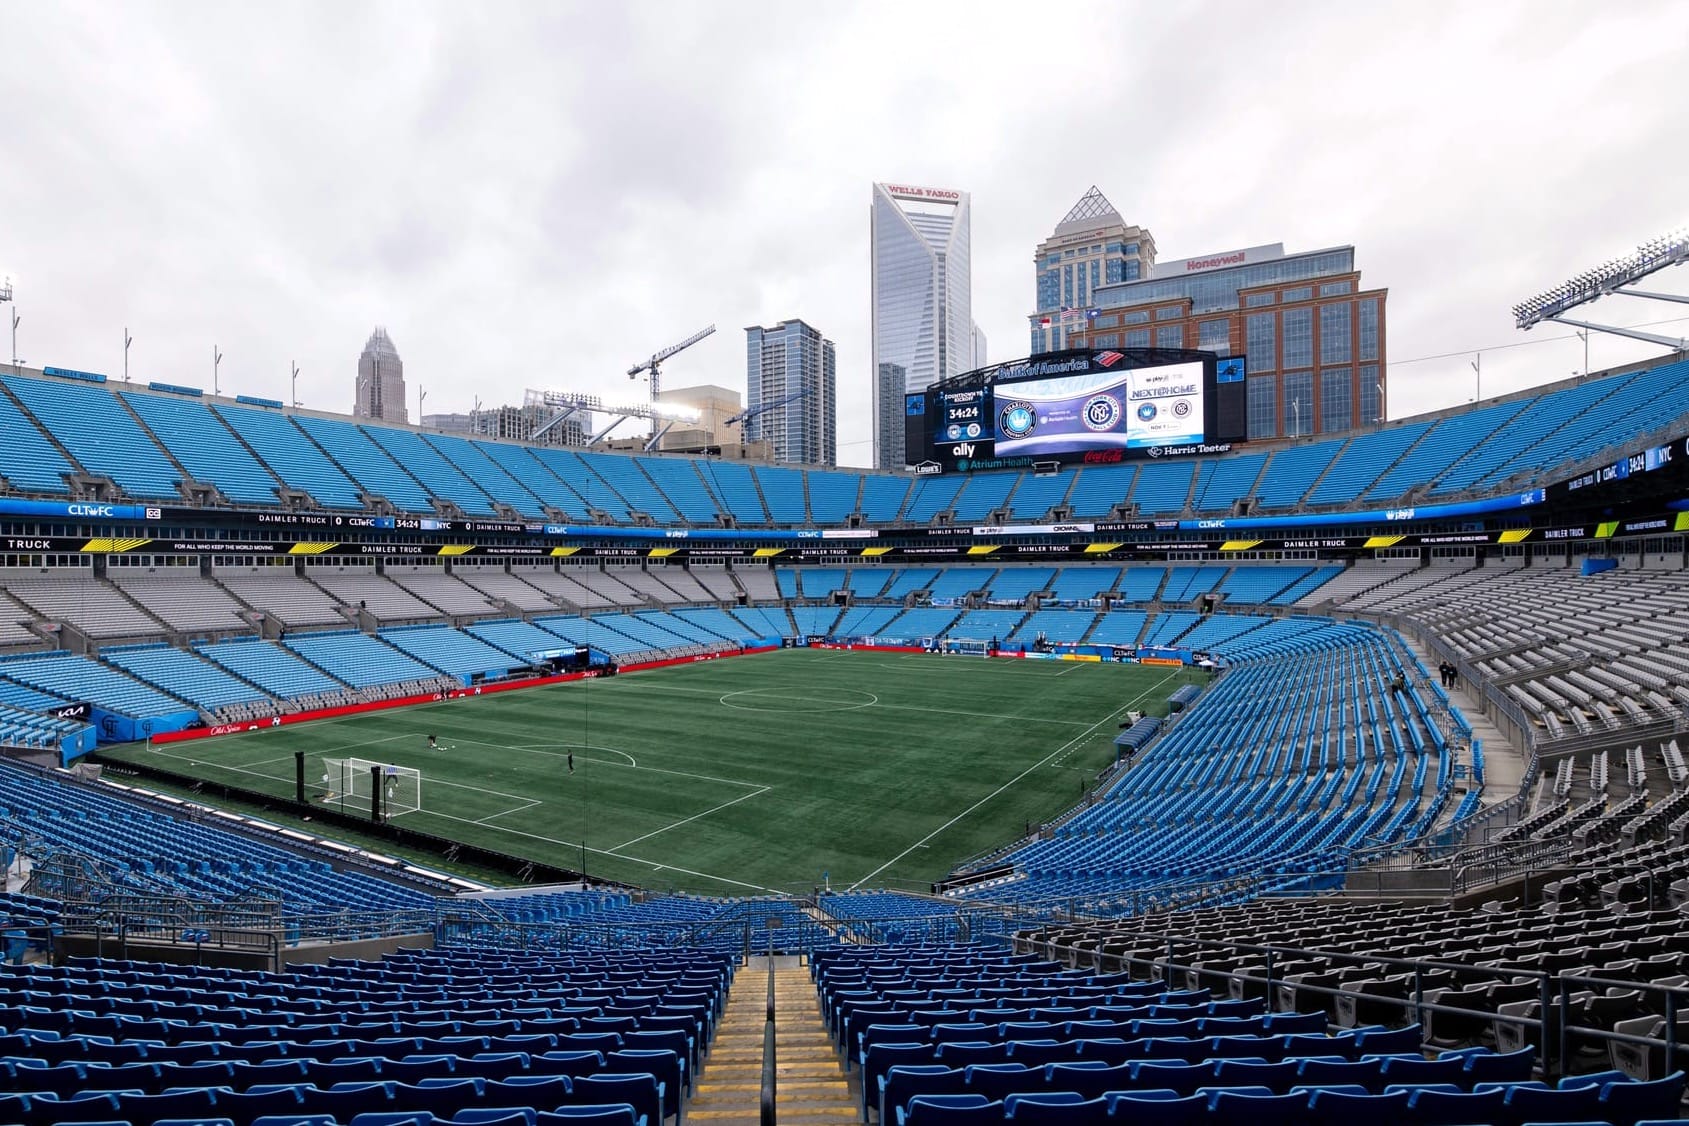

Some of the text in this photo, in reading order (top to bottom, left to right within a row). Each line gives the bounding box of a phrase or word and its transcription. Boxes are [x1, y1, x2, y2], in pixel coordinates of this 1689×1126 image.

[888, 185, 959, 199] WELLS FARGO
[1186, 252, 1245, 270] Honeywell
[997, 359, 1089, 379] Bank of America
[949, 407, 978, 419] 34:24
[953, 442, 975, 458] ally
[1164, 444, 1231, 455] Harris Teeter
[1658, 446, 1672, 464] NYC
[1629, 455, 1645, 473] 34:24
[259, 514, 326, 524] DAIMLER TRUCK
[335, 517, 342, 526] 0
[396, 520, 419, 528] 34:24
[1545, 528, 1584, 538] DAIMLER TRUCK
[8, 539, 50, 549] TRUCK
[362, 545, 422, 553] DAIMLER TRUCK
[210, 725, 241, 735] Old Spice
